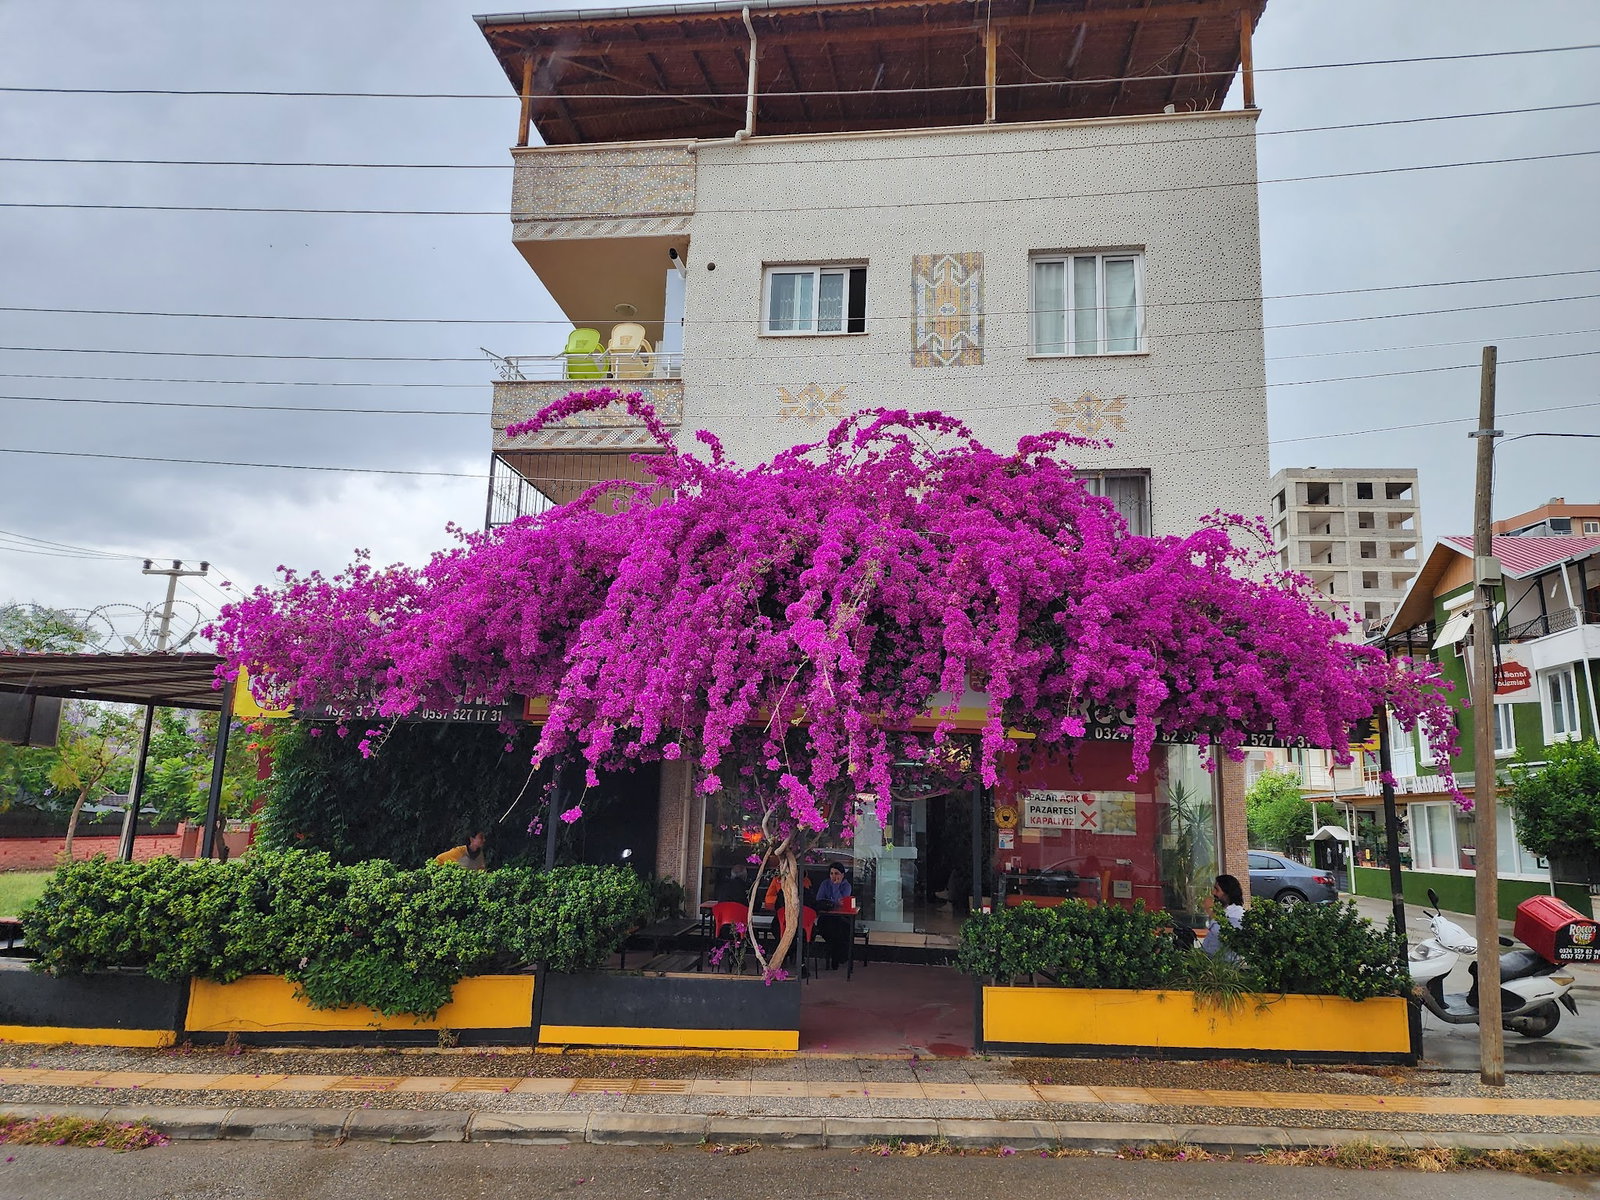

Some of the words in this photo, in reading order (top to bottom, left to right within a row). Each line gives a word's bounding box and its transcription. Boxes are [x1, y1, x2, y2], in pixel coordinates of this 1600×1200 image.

[356, 705, 377, 717] 39
[453, 709, 473, 720] 527
[477, 709, 488, 721] 17
[490, 710, 502, 722] 31
[1095, 727, 1128, 740] 0324
[1251, 733, 1274, 747] 527
[1029, 793, 1058, 802] PAZAR
[1030, 805, 1077, 815] PAZARTESİ
[1030, 816, 1074, 826] KAPALIYIZ
[1573, 933, 1592, 944] CHEF
